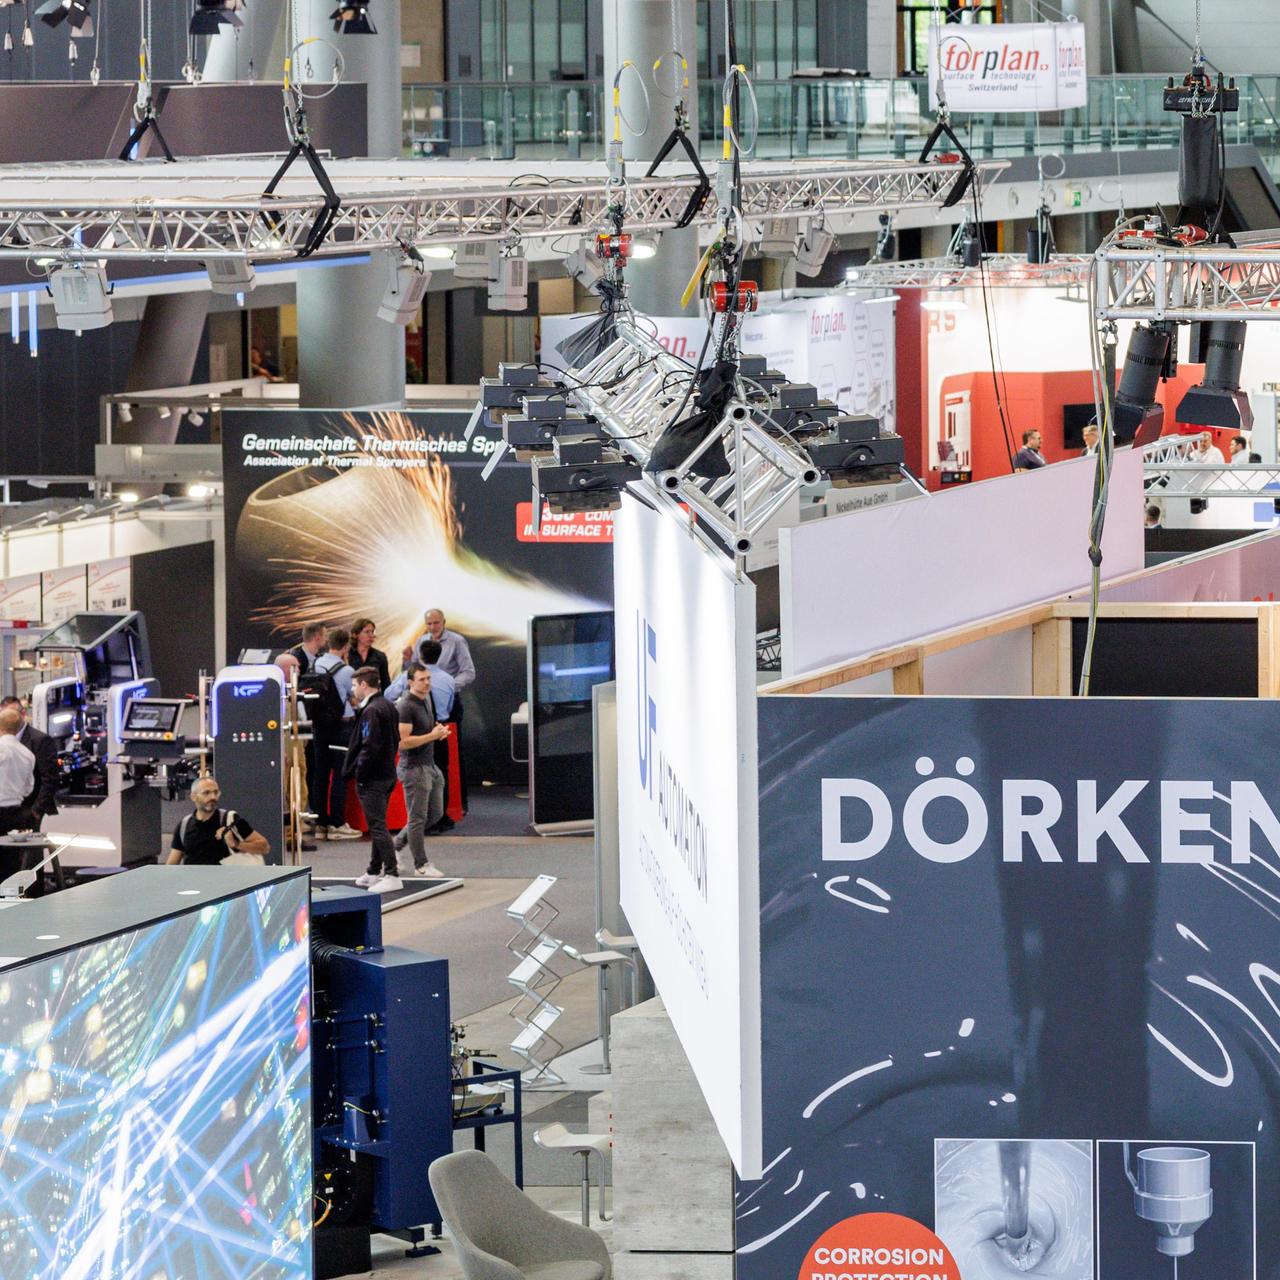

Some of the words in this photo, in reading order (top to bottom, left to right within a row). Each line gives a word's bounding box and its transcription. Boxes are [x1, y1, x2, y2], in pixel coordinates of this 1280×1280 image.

[945, 44, 1040, 79] forplan
[991, 72, 1036, 81] technology
[242, 434, 357, 452] Gemeinschaft
[362, 435, 467, 453] Thermisches
[244, 455, 310, 467] Association
[312, 456, 324, 467] of
[327, 455, 373, 467] Thermal
[376, 457, 427, 469] Sprayers
[542, 524, 602, 537] SURFACE
[814, 1247, 945, 1266] CORROSION
